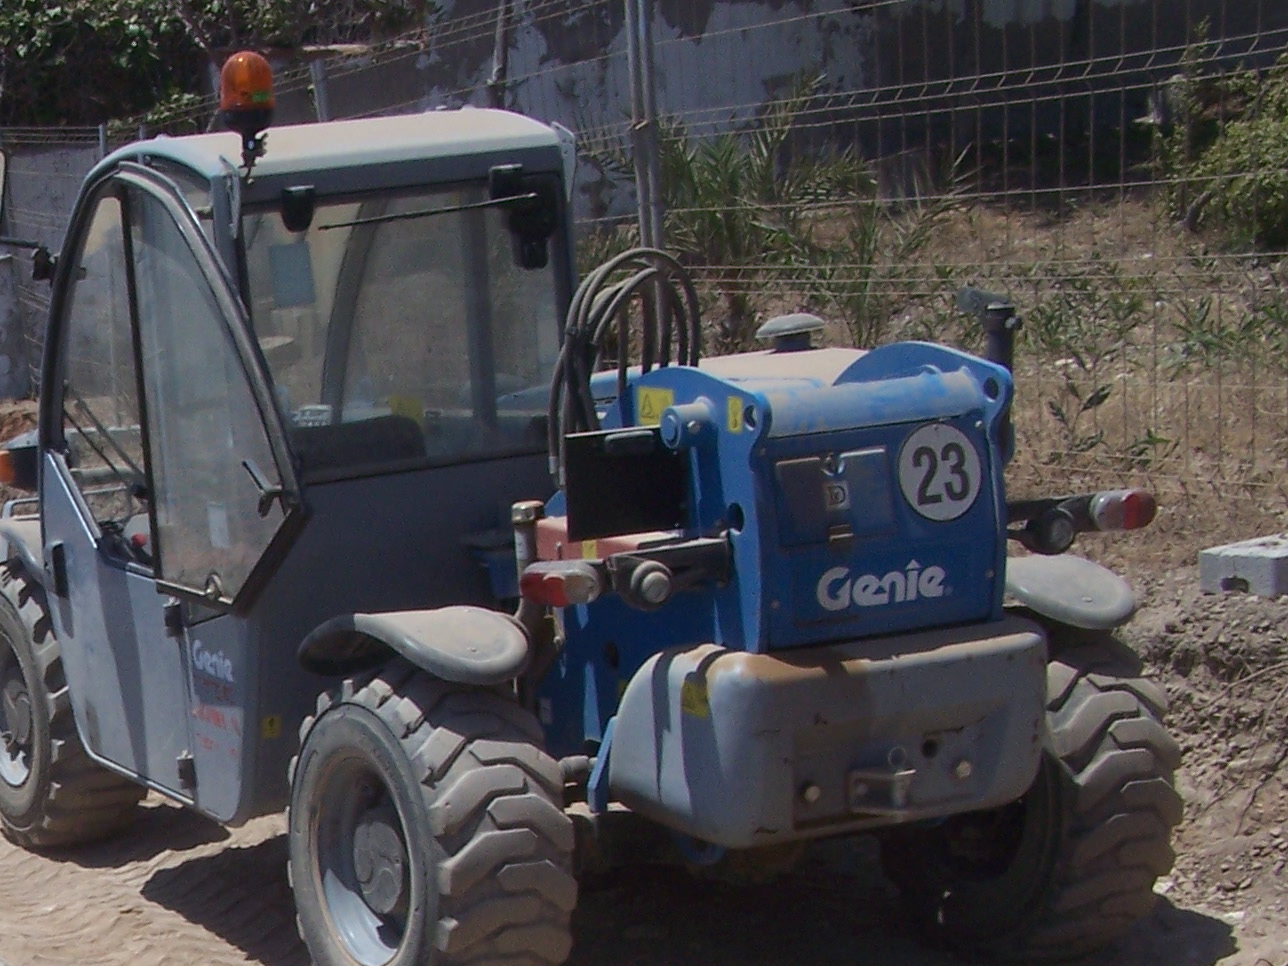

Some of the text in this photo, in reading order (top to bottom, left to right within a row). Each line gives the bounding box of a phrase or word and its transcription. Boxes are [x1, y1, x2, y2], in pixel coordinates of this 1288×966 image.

[913, 442, 970, 506] 23
[817, 559, 946, 611] Genie
[192, 639, 234, 682] Genie
